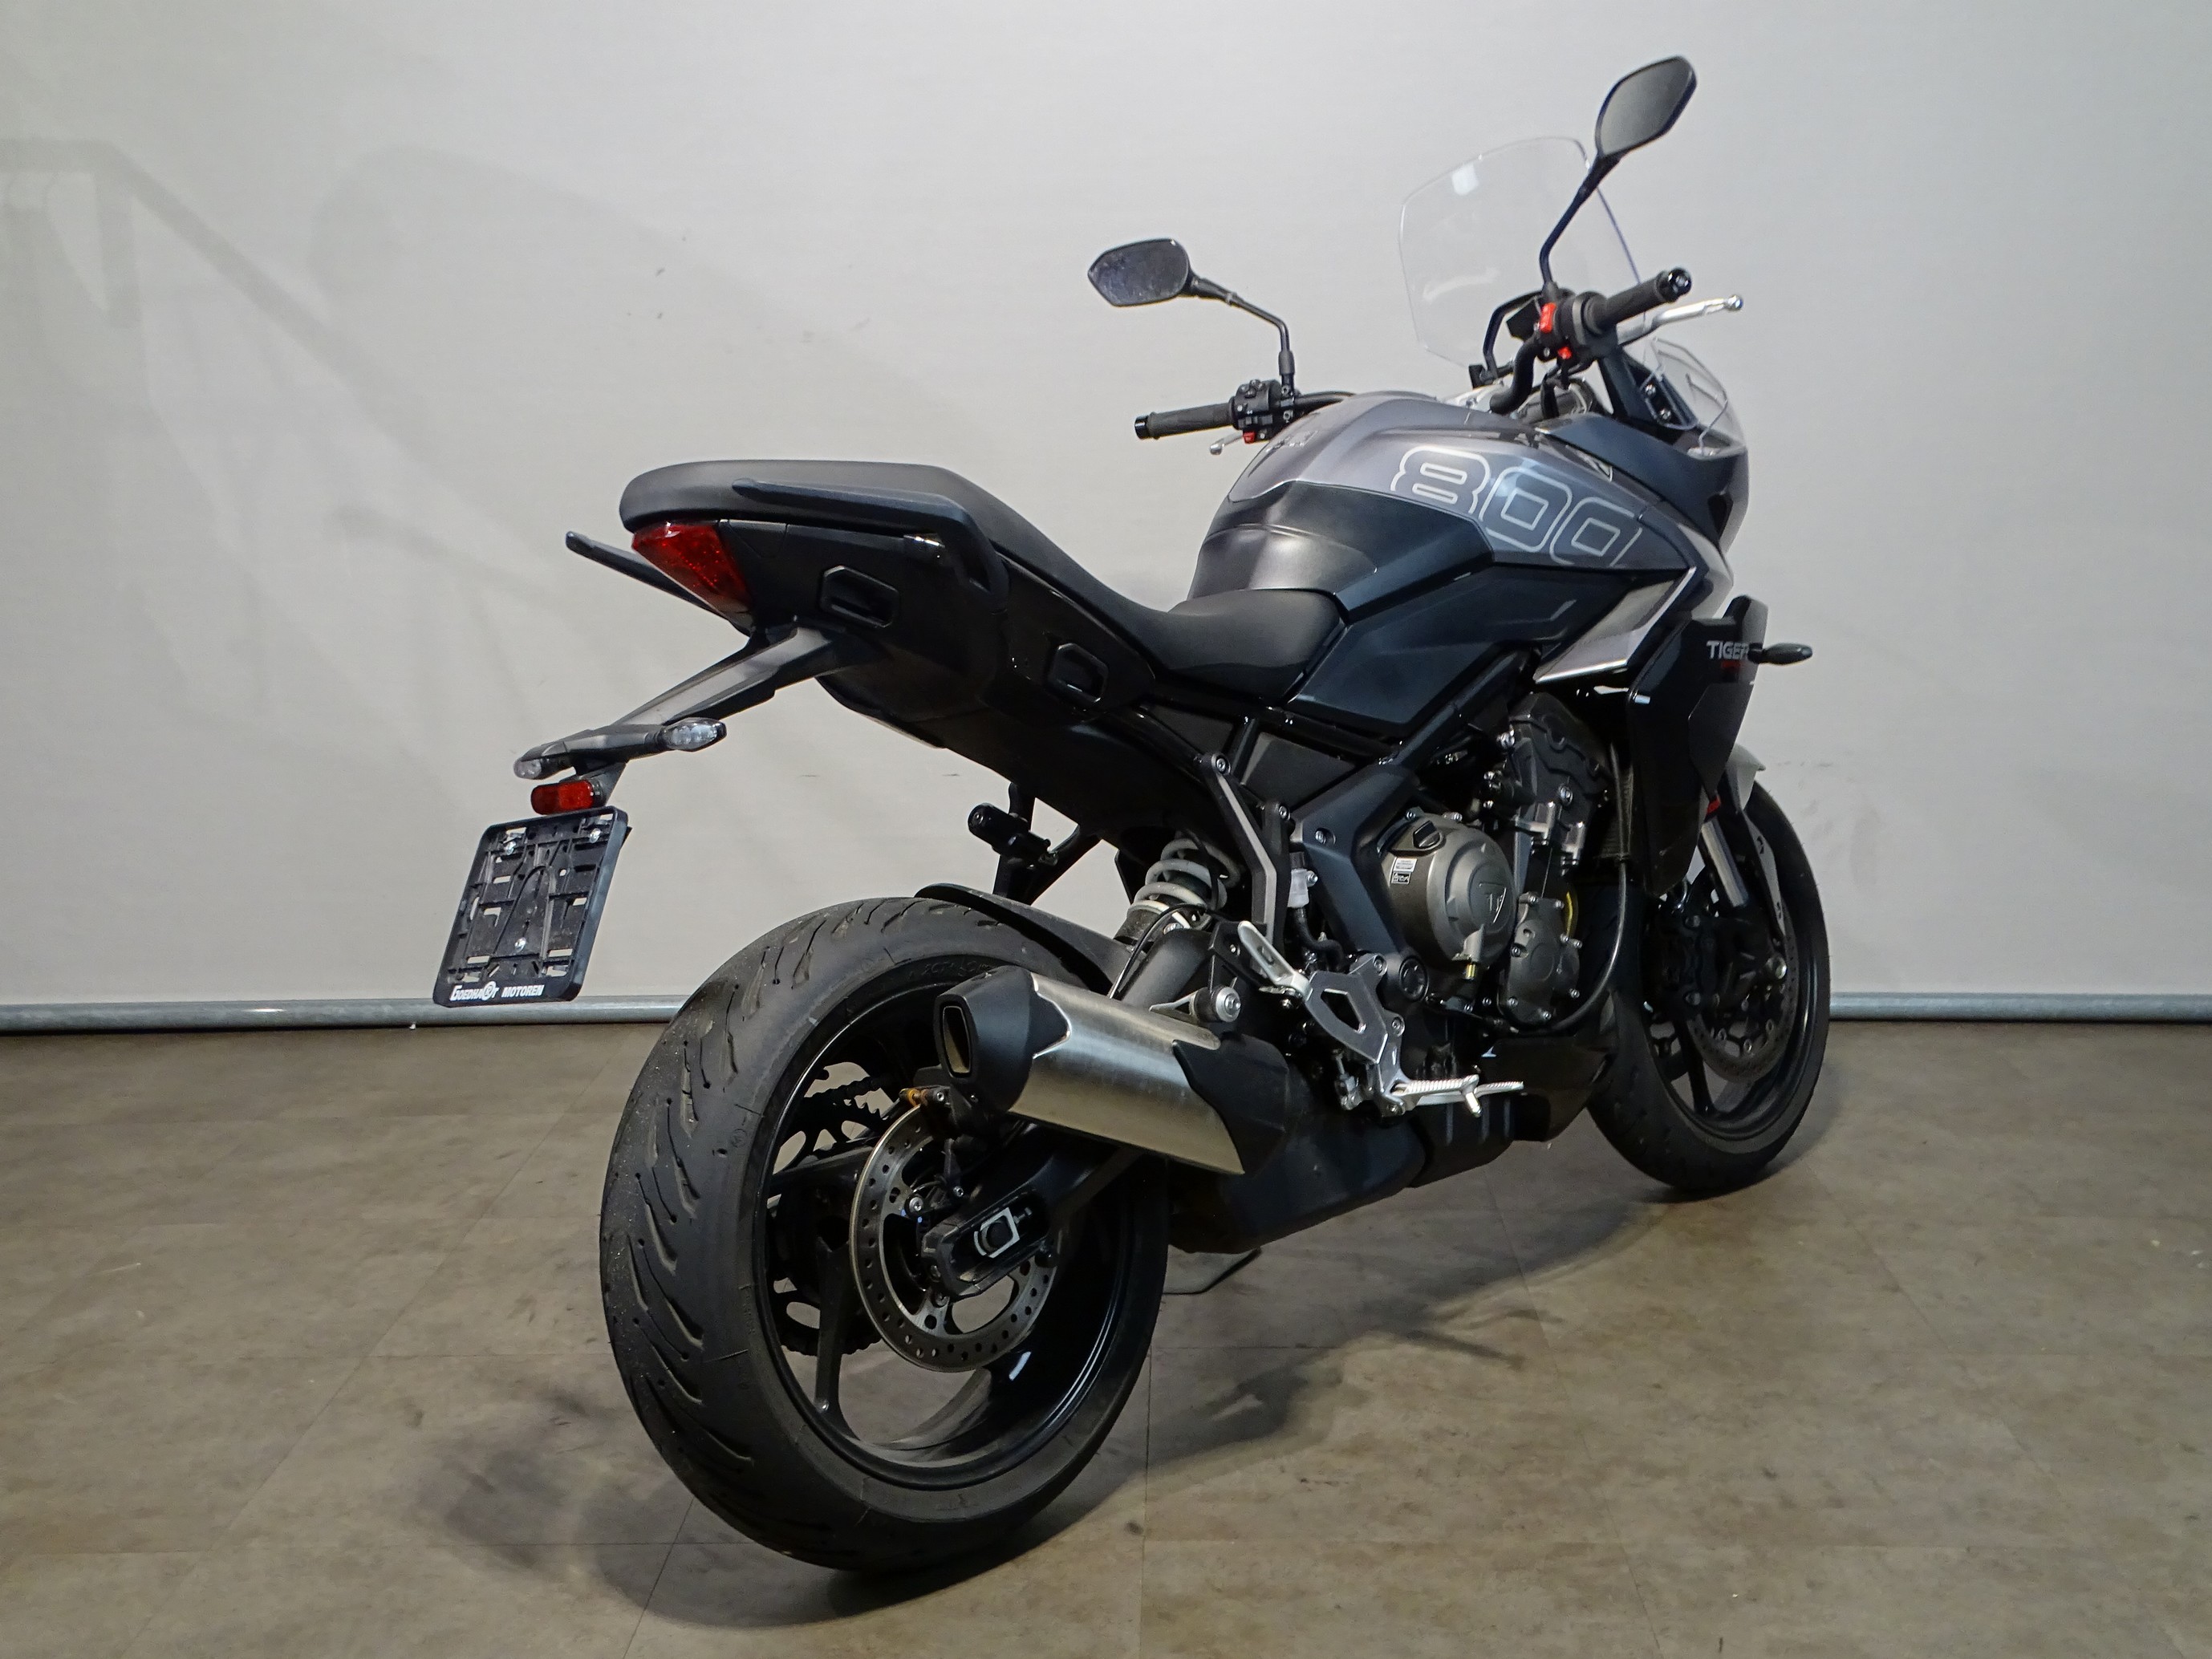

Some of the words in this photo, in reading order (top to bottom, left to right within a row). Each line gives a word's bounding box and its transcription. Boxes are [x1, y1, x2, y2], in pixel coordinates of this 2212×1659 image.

[1390, 444, 1643, 567] 800
[1706, 639, 1749, 660] TIGER
[501, 984, 545, 998] MOTOREN
